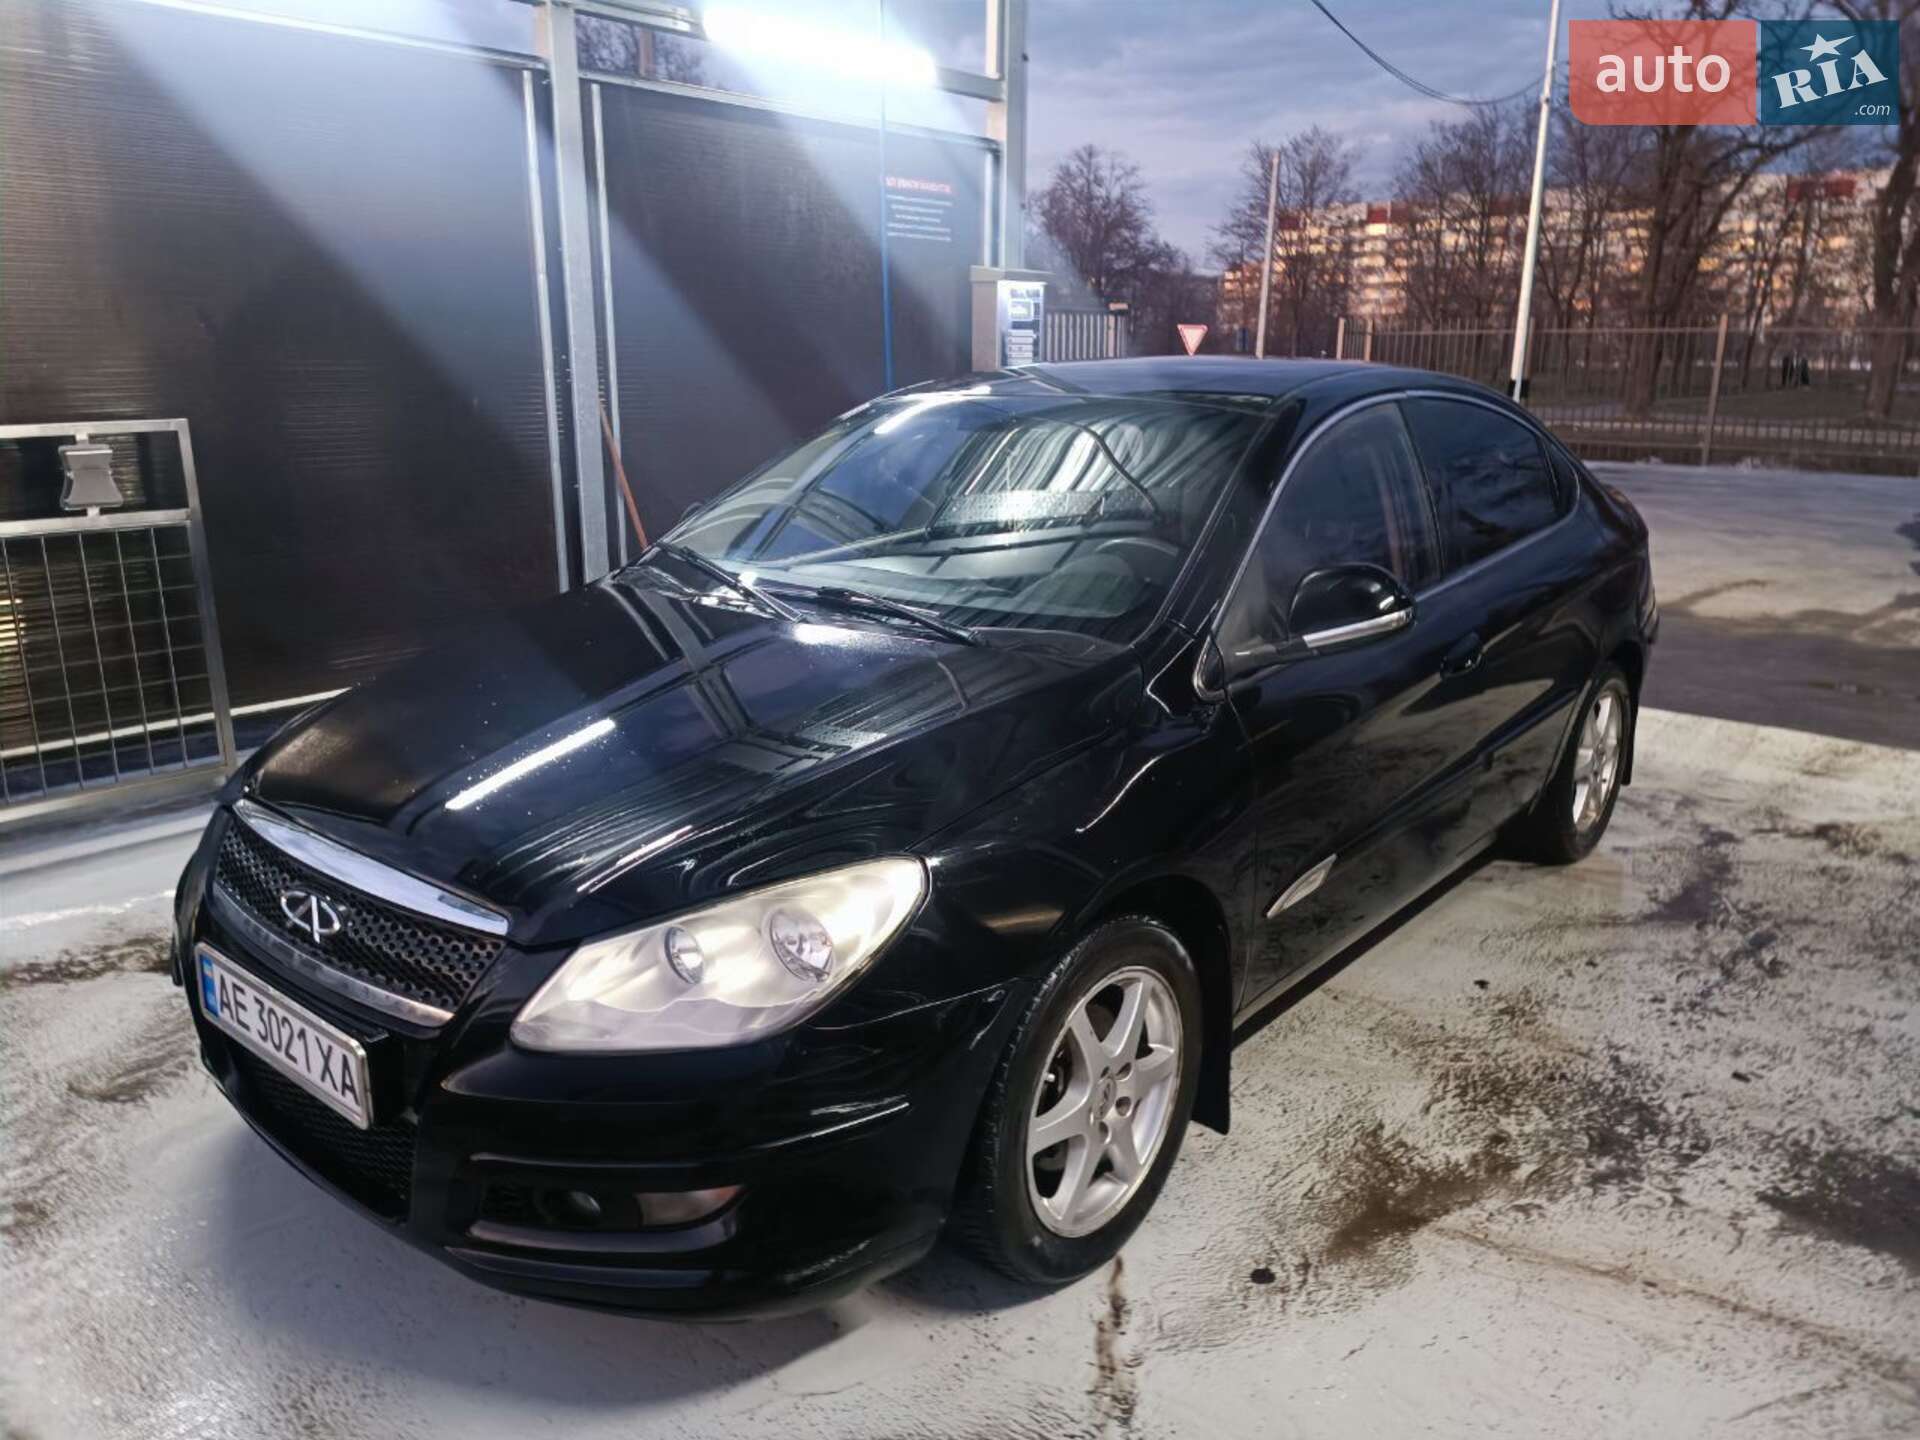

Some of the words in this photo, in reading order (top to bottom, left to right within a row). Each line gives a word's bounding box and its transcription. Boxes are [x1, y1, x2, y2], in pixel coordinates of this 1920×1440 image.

[219, 973, 250, 1032] AE
[253, 995, 312, 1074] 3021
[315, 1035, 361, 1106] XA
